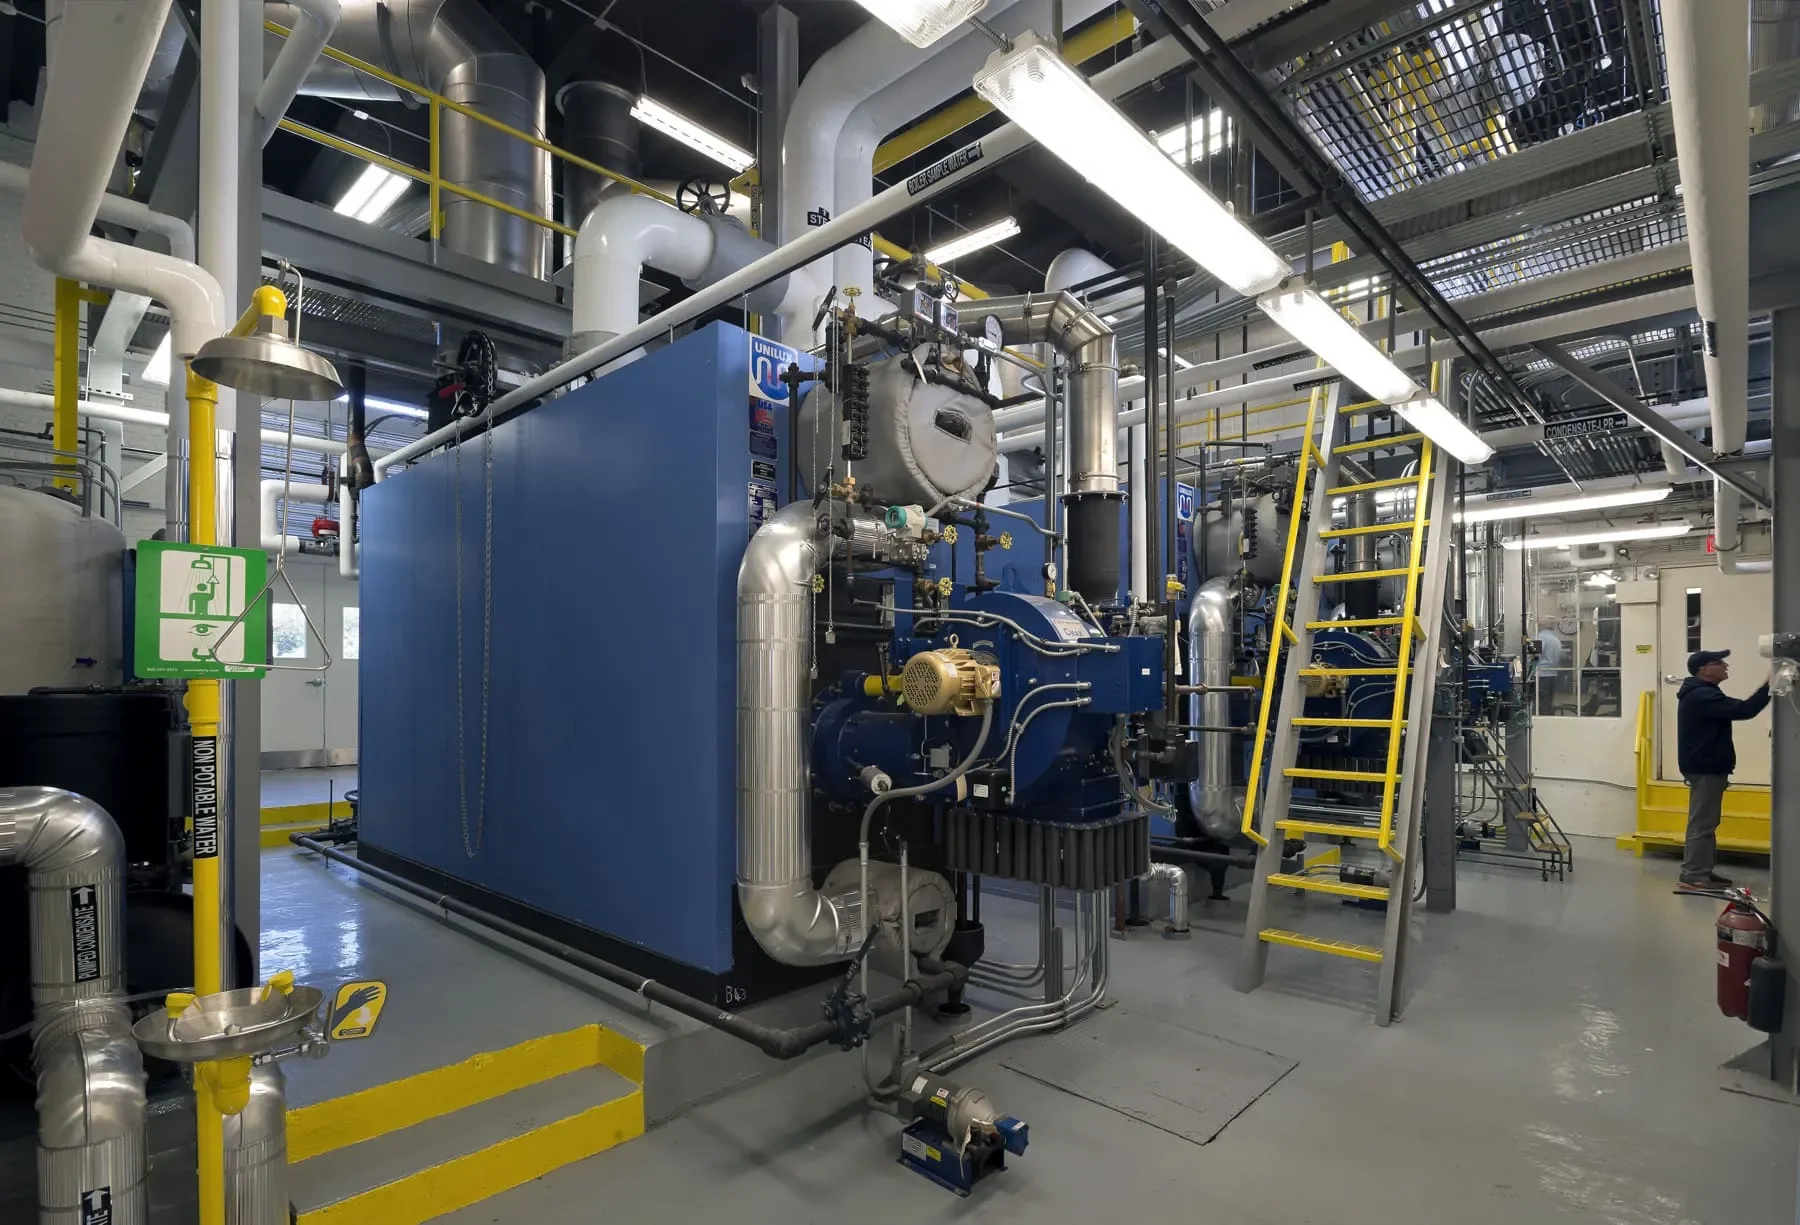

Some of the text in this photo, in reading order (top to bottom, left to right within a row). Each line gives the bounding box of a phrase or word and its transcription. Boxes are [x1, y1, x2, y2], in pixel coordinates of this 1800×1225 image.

[908, 149, 969, 194] BOILER SAMPLE WATER
[810, 214, 828, 225] STE
[755, 342, 793, 362] UNILUX
[1546, 417, 1614, 438] CONDENSATE-LPR
[194, 740, 217, 855] NON POTABLE WATER
[75, 905, 97, 980] PUMPED CONDENSATE
